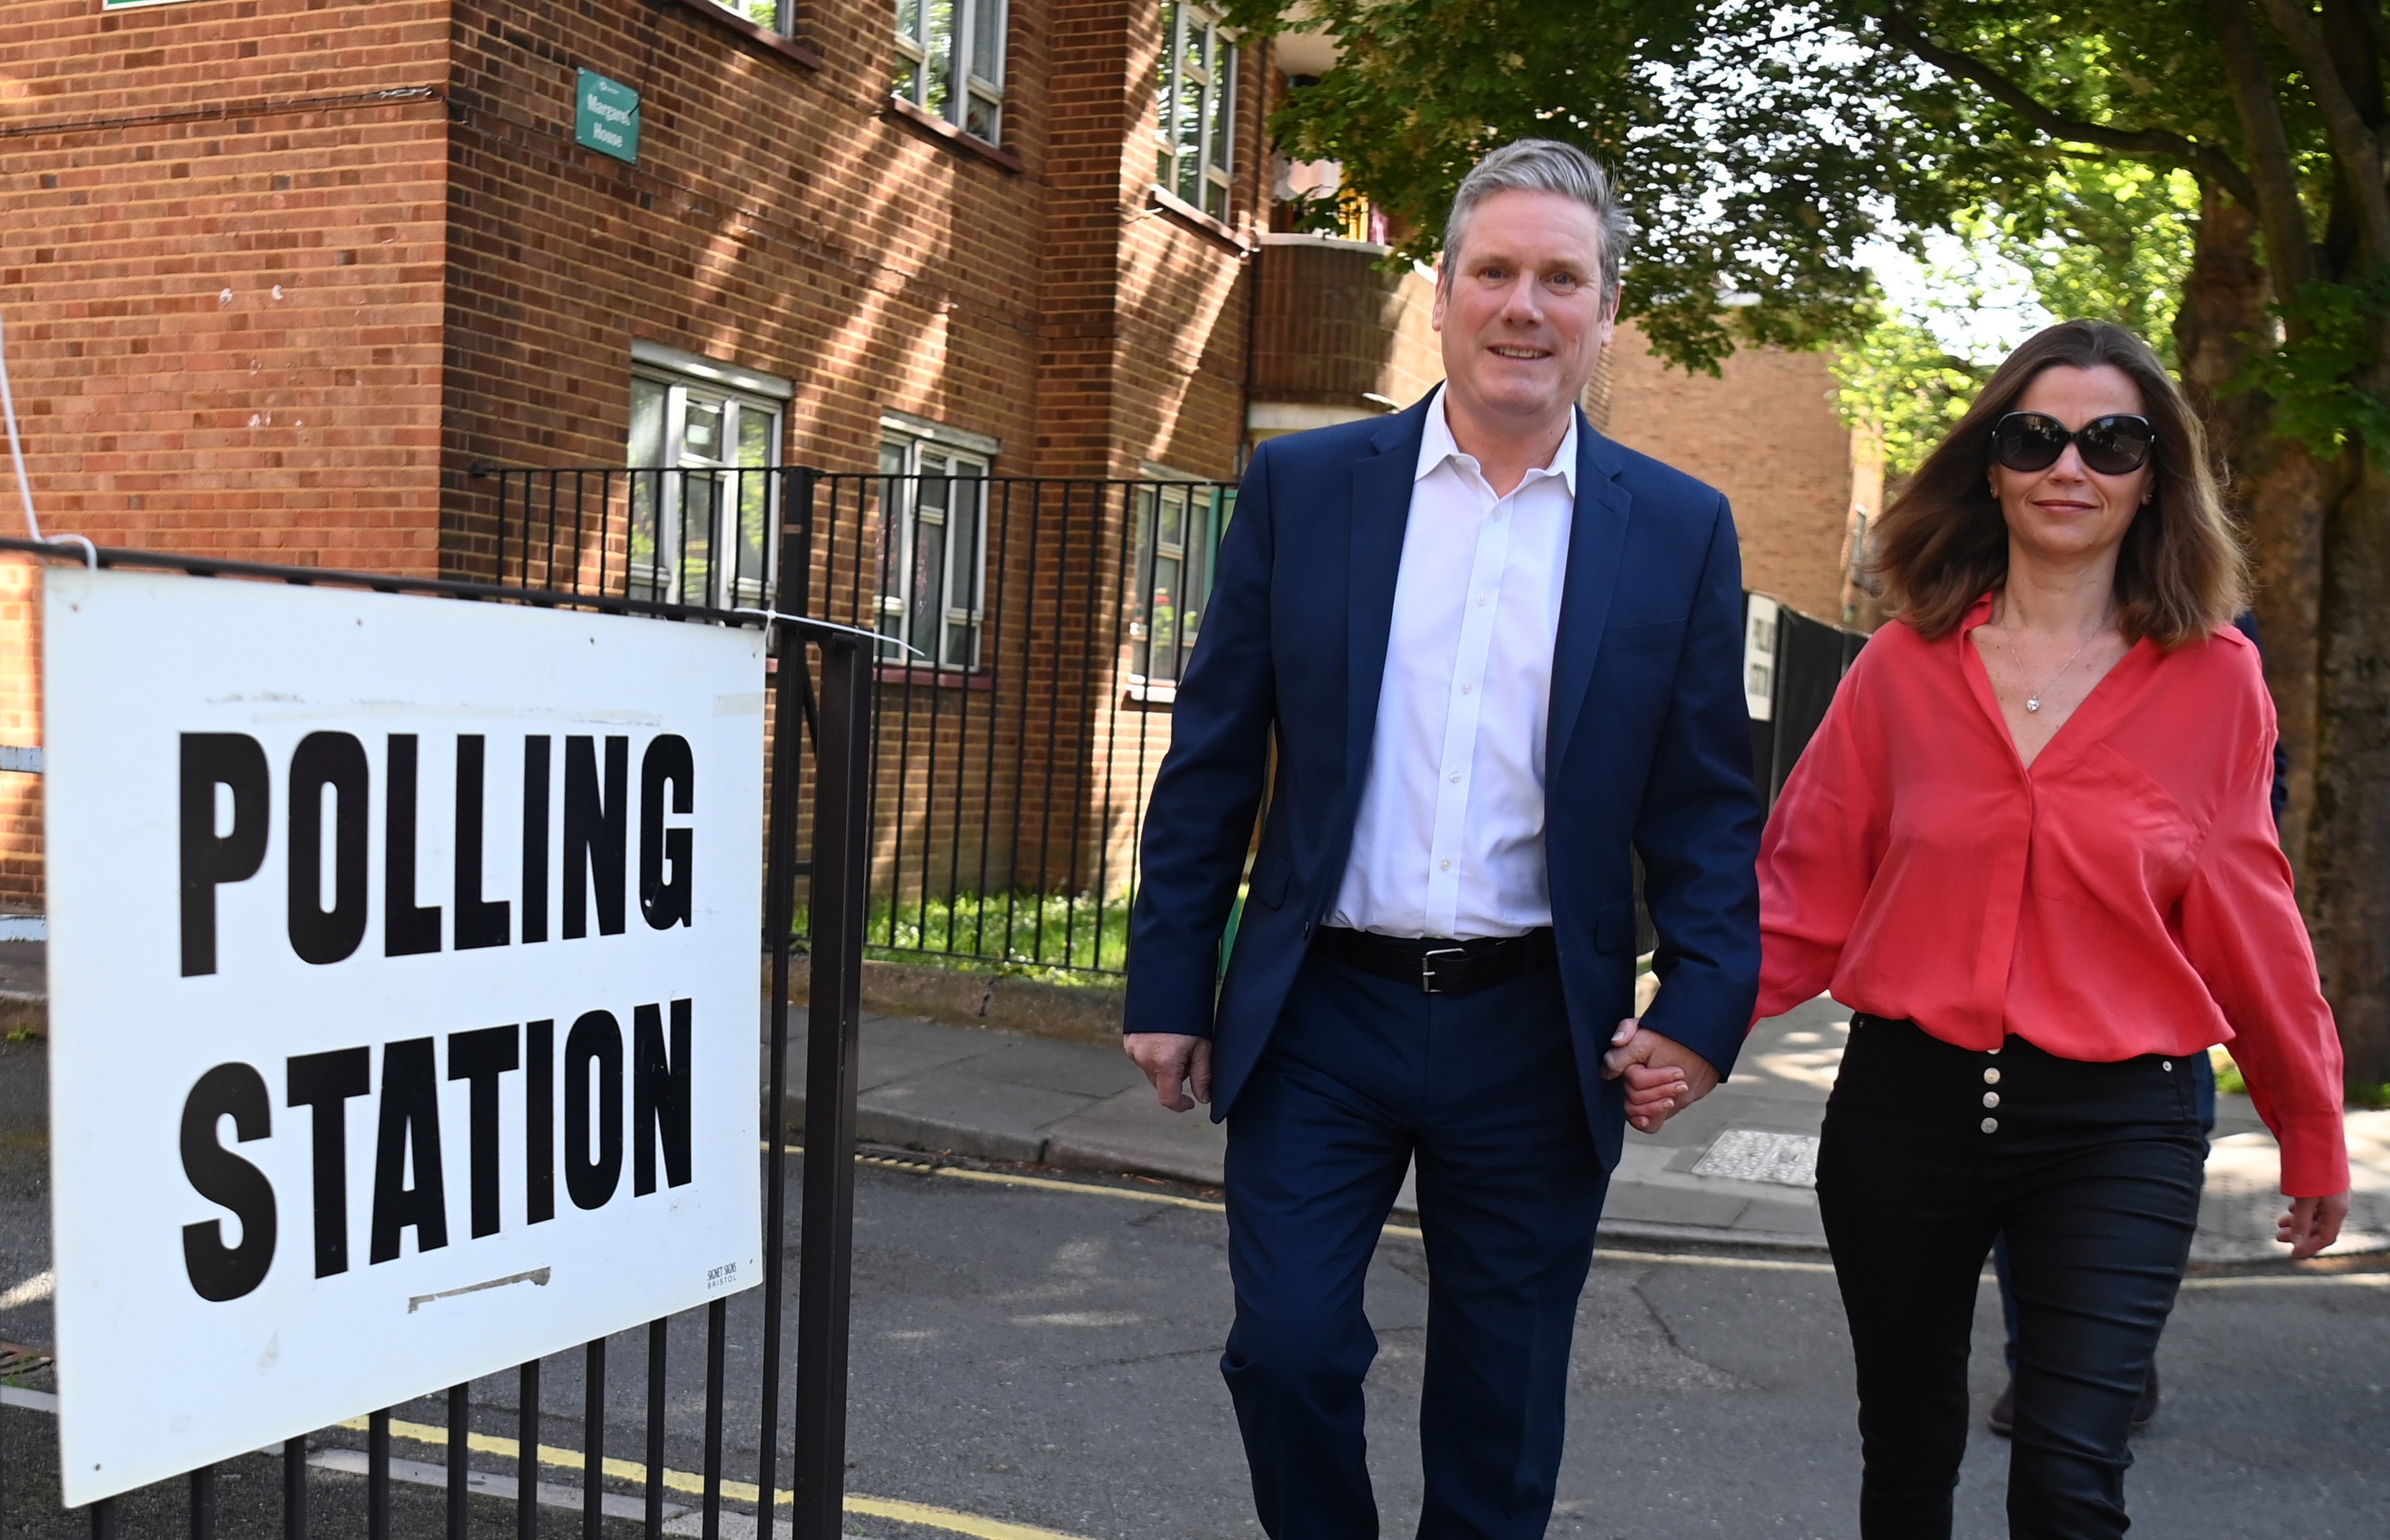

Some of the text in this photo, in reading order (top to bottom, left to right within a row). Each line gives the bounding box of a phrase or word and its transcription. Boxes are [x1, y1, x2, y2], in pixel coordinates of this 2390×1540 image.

[587, 93, 631, 126] Margaret
[593, 121, 623, 148] House
[179, 730, 694, 978] POLLING
[179, 997, 692, 1302] STATION
[707, 1261, 737, 1282] SIGNET SIGNS
[707, 1274, 737, 1289] BRISTOL
